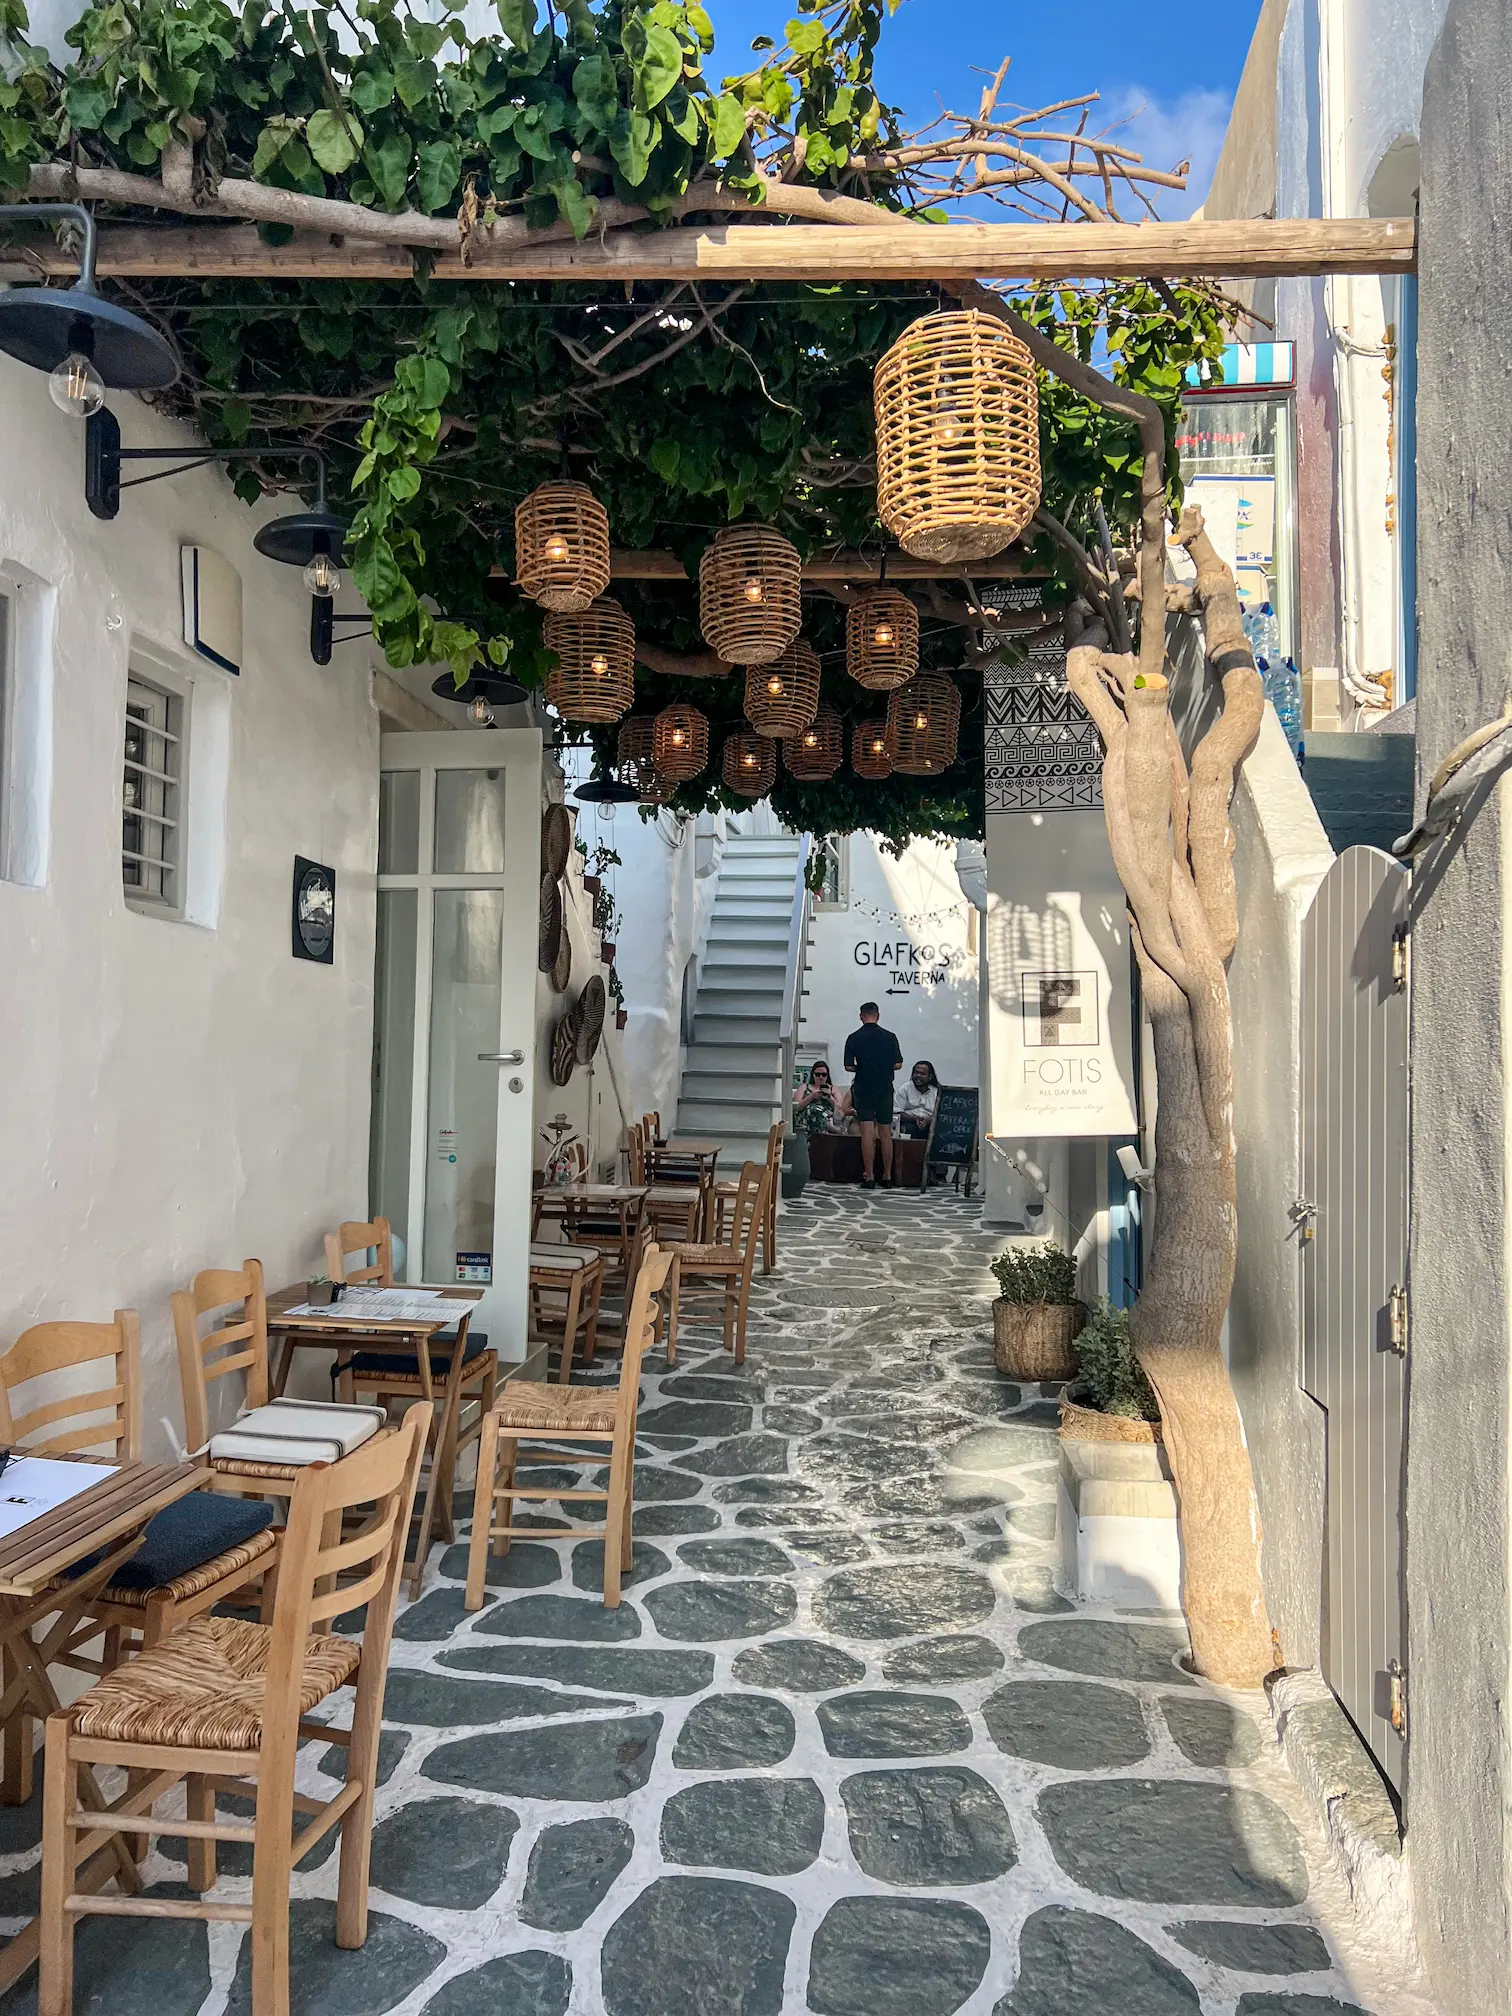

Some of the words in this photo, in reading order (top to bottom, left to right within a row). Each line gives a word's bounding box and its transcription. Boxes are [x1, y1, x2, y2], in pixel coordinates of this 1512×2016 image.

[854, 941, 952, 967] GLAFKOS
[889, 971, 945, 985] TAVERNA
[1023, 1058, 1102, 1083] FOTIS
[1072, 1088, 1088, 1096] BAR
